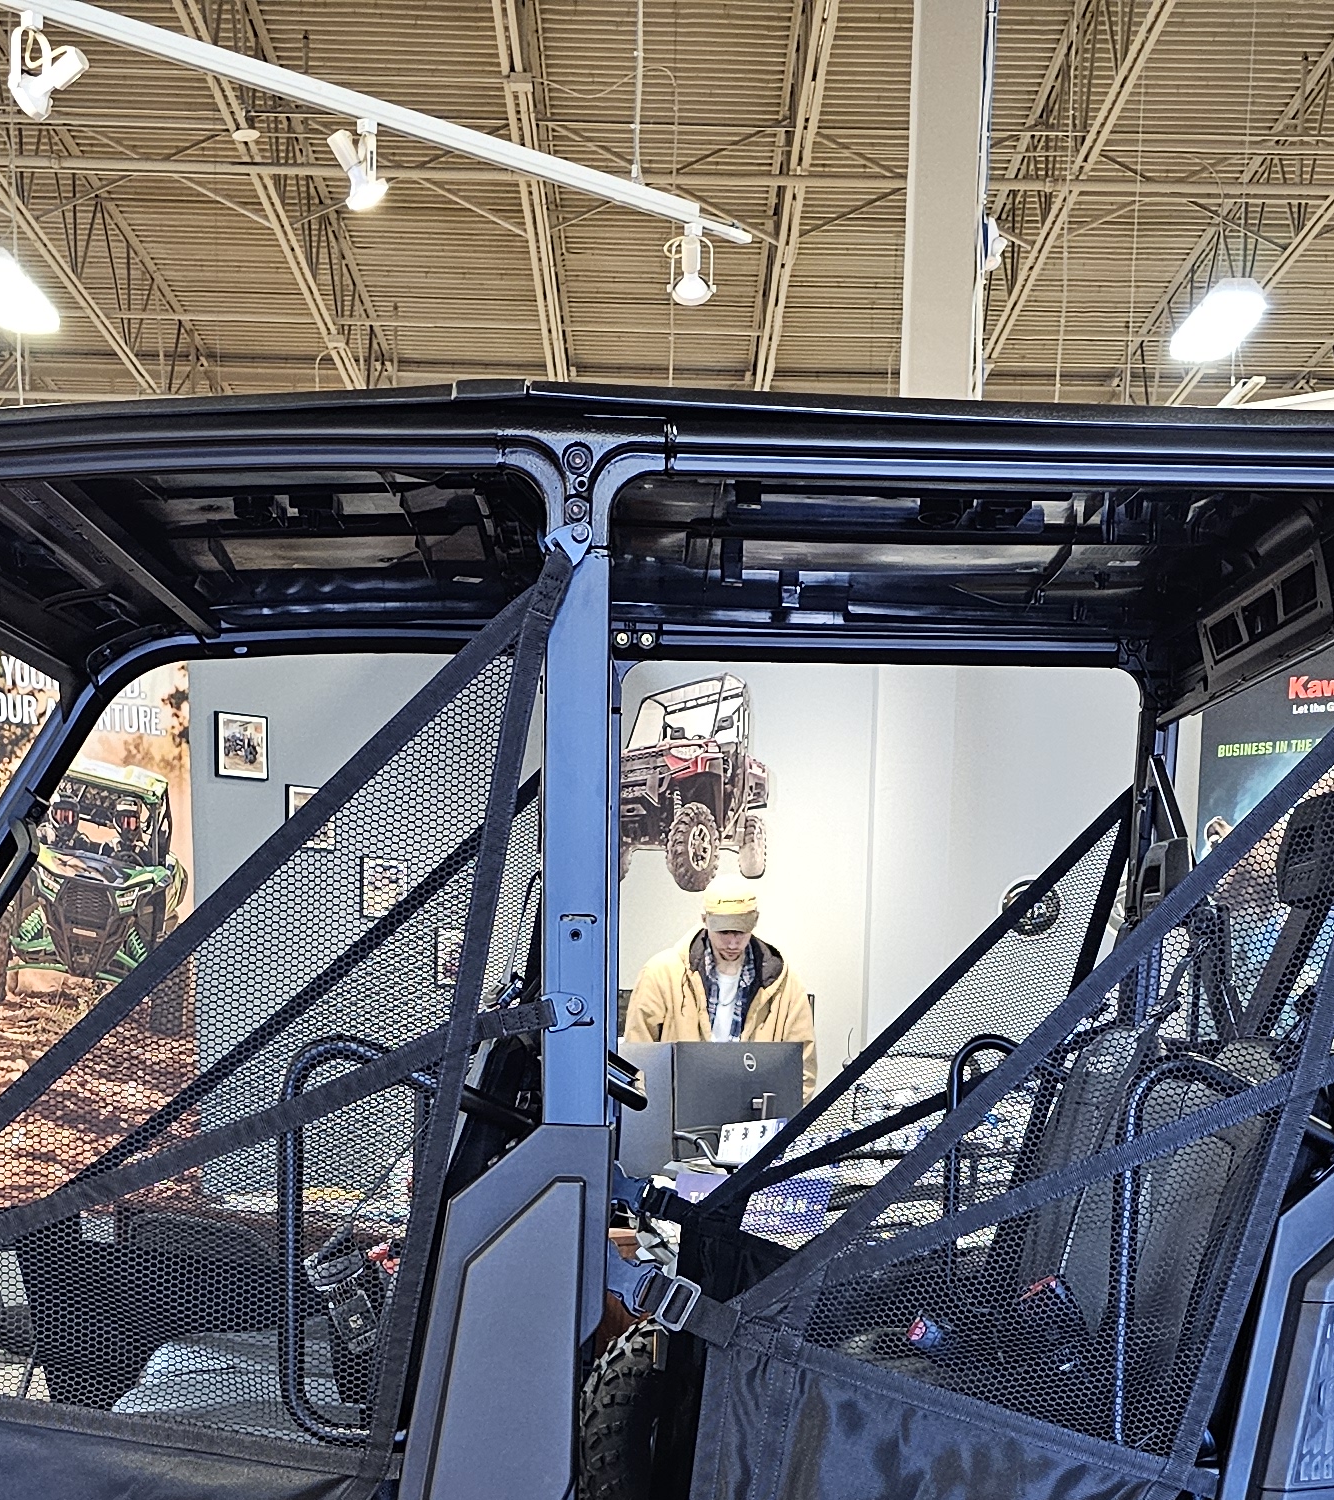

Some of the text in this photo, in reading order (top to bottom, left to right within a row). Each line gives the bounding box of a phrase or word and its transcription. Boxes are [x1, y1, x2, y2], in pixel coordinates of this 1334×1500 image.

[1292, 703, 1309, 715] Let
[1309, 702, 1326, 714] the
[1217, 744, 1273, 757] BUSINESS
[1275, 741, 1287, 753] IN
[1291, 739, 1313, 752] THE
